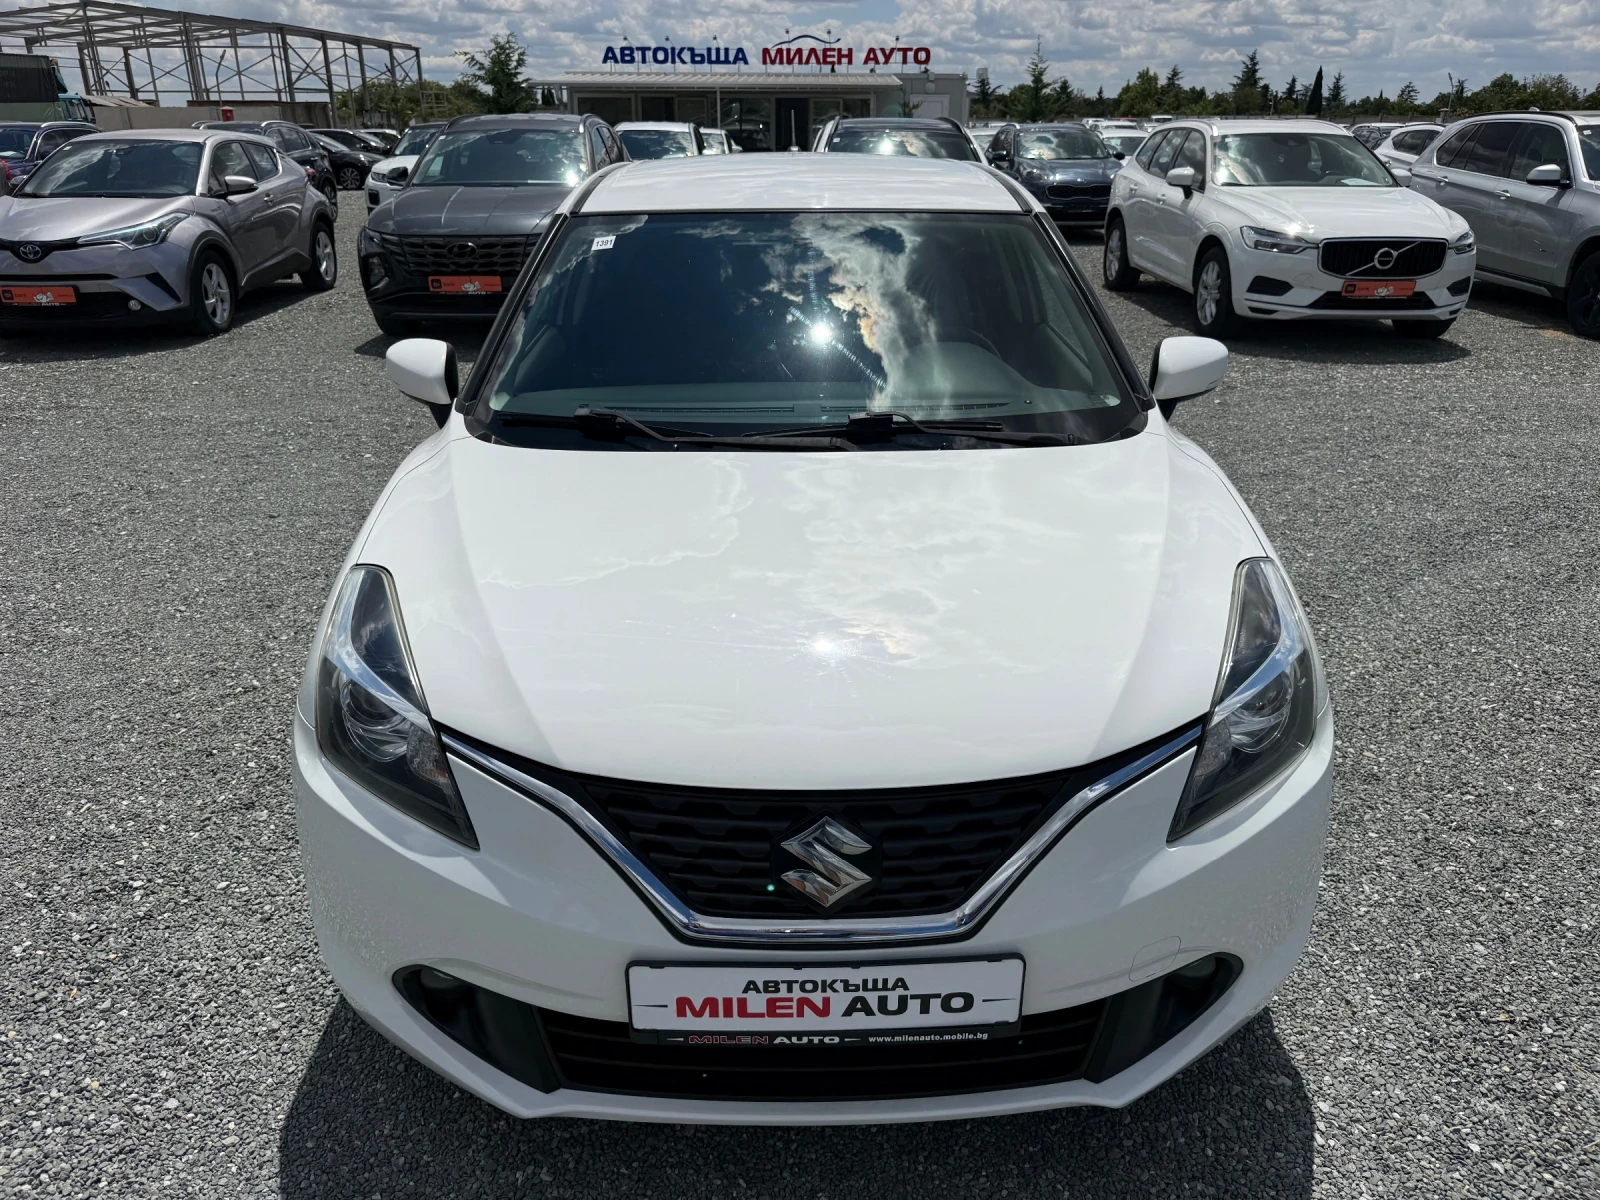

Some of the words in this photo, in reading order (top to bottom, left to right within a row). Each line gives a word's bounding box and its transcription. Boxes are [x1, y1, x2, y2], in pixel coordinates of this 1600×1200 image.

[761, 47, 853, 66] МИЛЕН
[863, 47, 931, 65] АУТО
[596, 239, 613, 247] 1391
[675, 996, 831, 1018] MILEN
[841, 992, 975, 1017] AUTO
[689, 1035, 769, 1044] MILEN
[773, 1036, 840, 1044] AUTO
[868, 1032, 988, 1043] www.milenauto.mobile.bg
